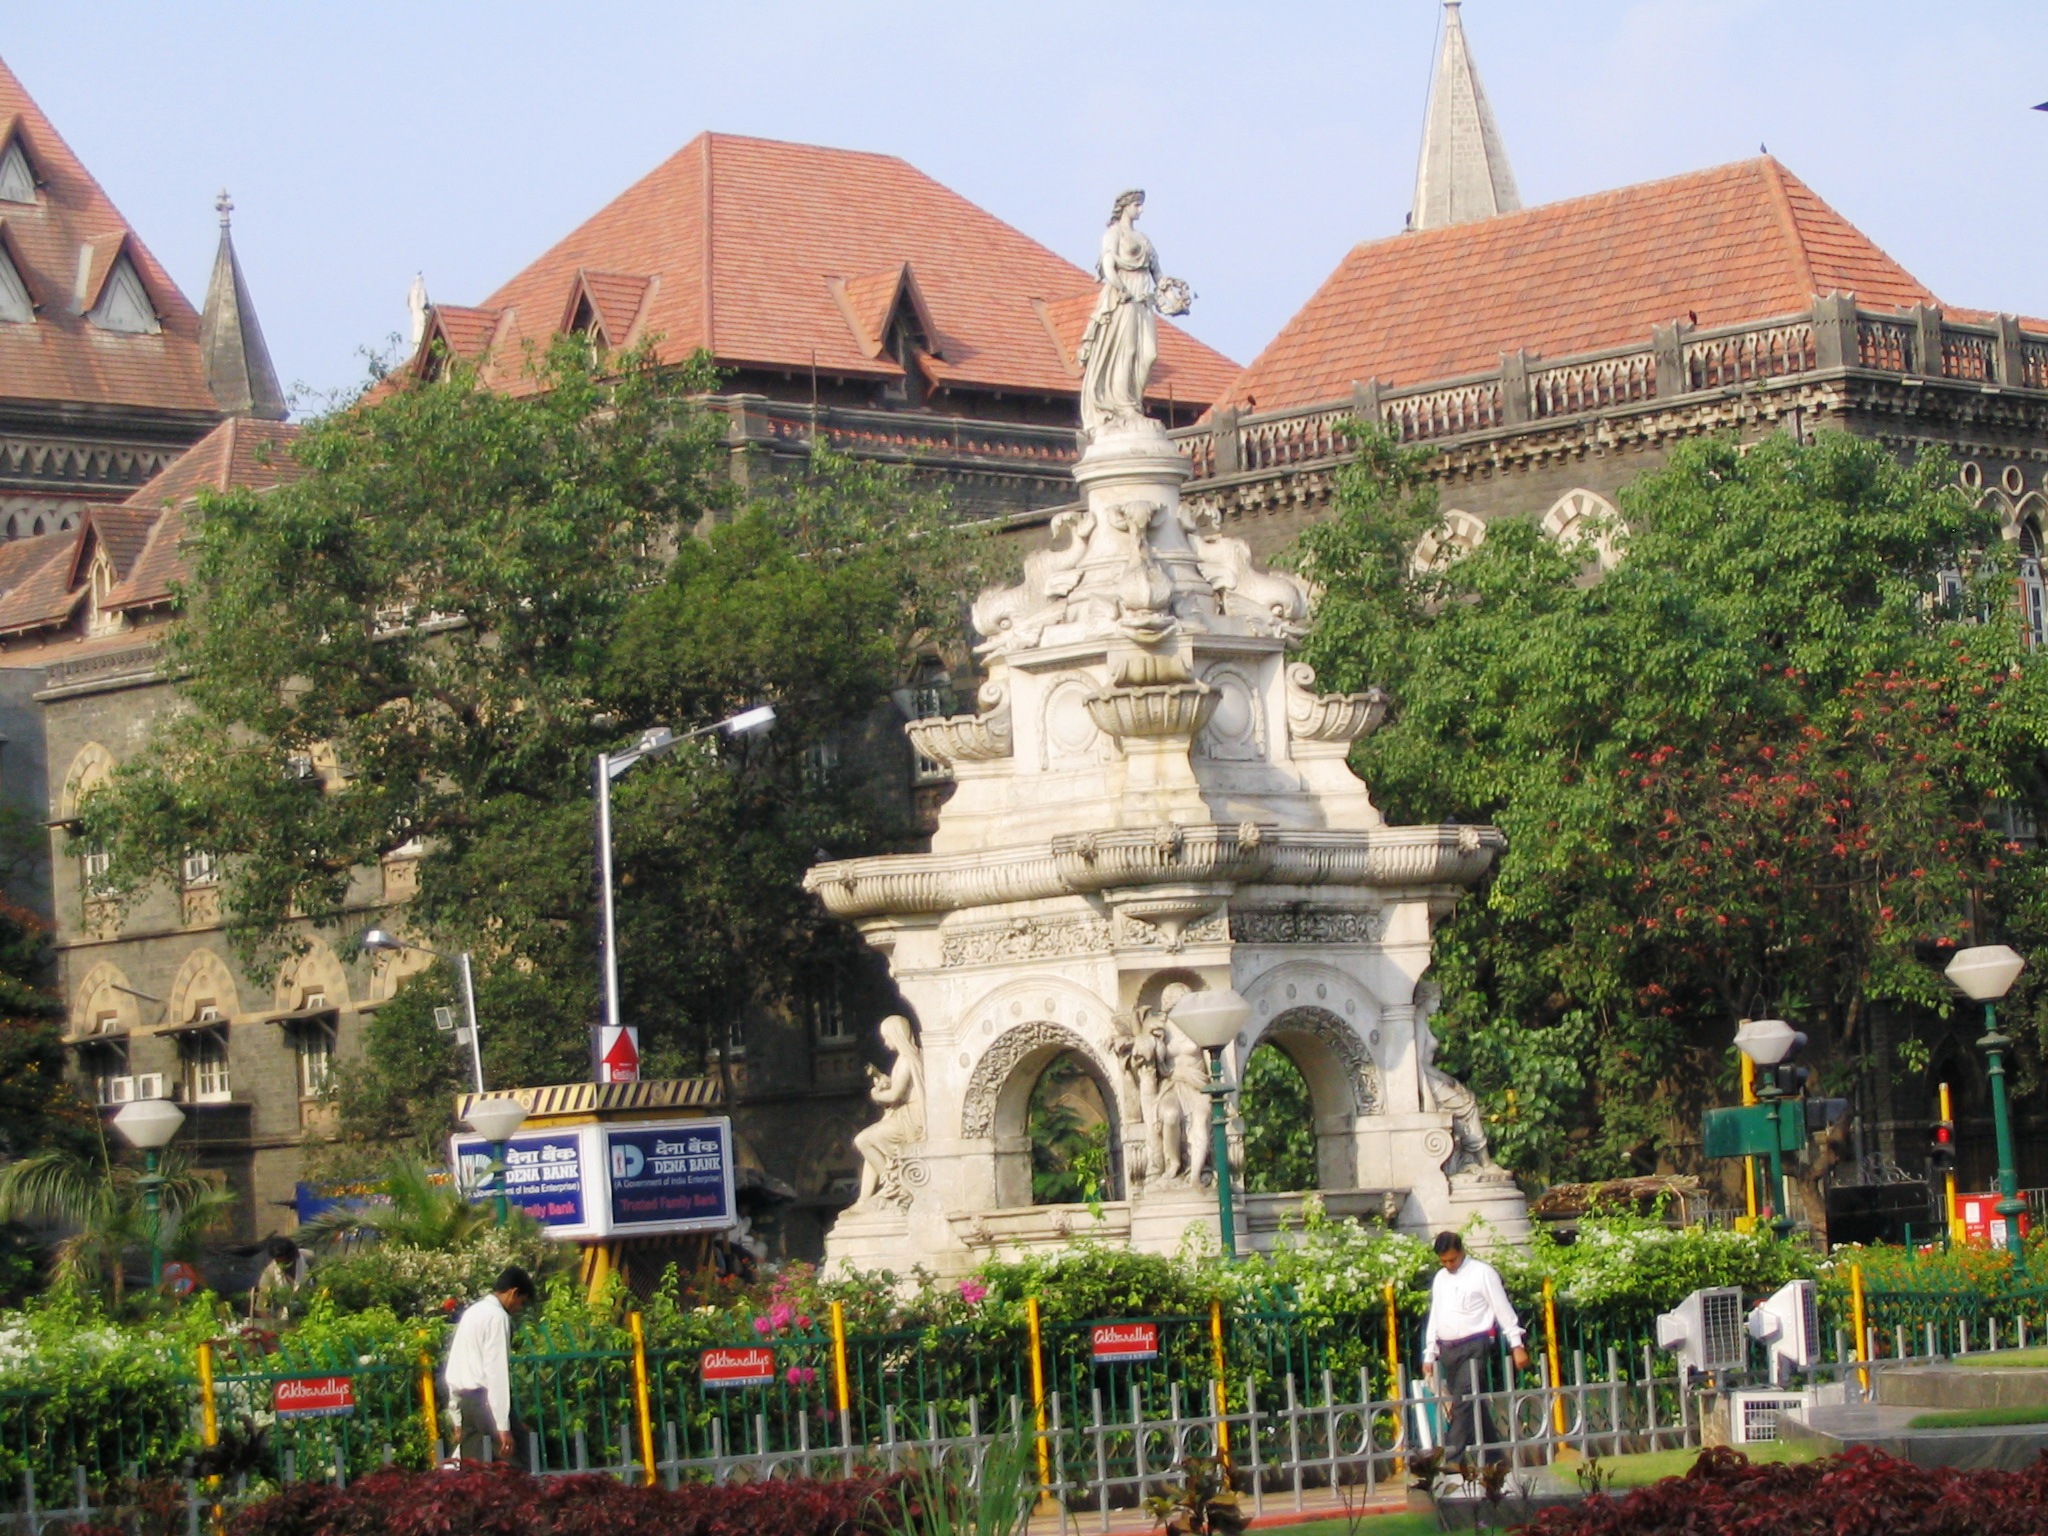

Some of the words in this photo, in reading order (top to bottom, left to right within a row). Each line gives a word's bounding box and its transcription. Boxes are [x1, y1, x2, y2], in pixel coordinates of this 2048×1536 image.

[656, 1139, 685, 1155] देना
[506, 1148, 540, 1164] देना
[655, 1160, 686, 1174] DENA
[689, 1157, 721, 1172] BANK
[505, 1168, 540, 1183] DENA
[542, 1165, 579, 1181] BANK
[523, 1184, 540, 1195] India
[541, 1181, 580, 1193] Enterprise)
[548, 1200, 576, 1216] Bank
